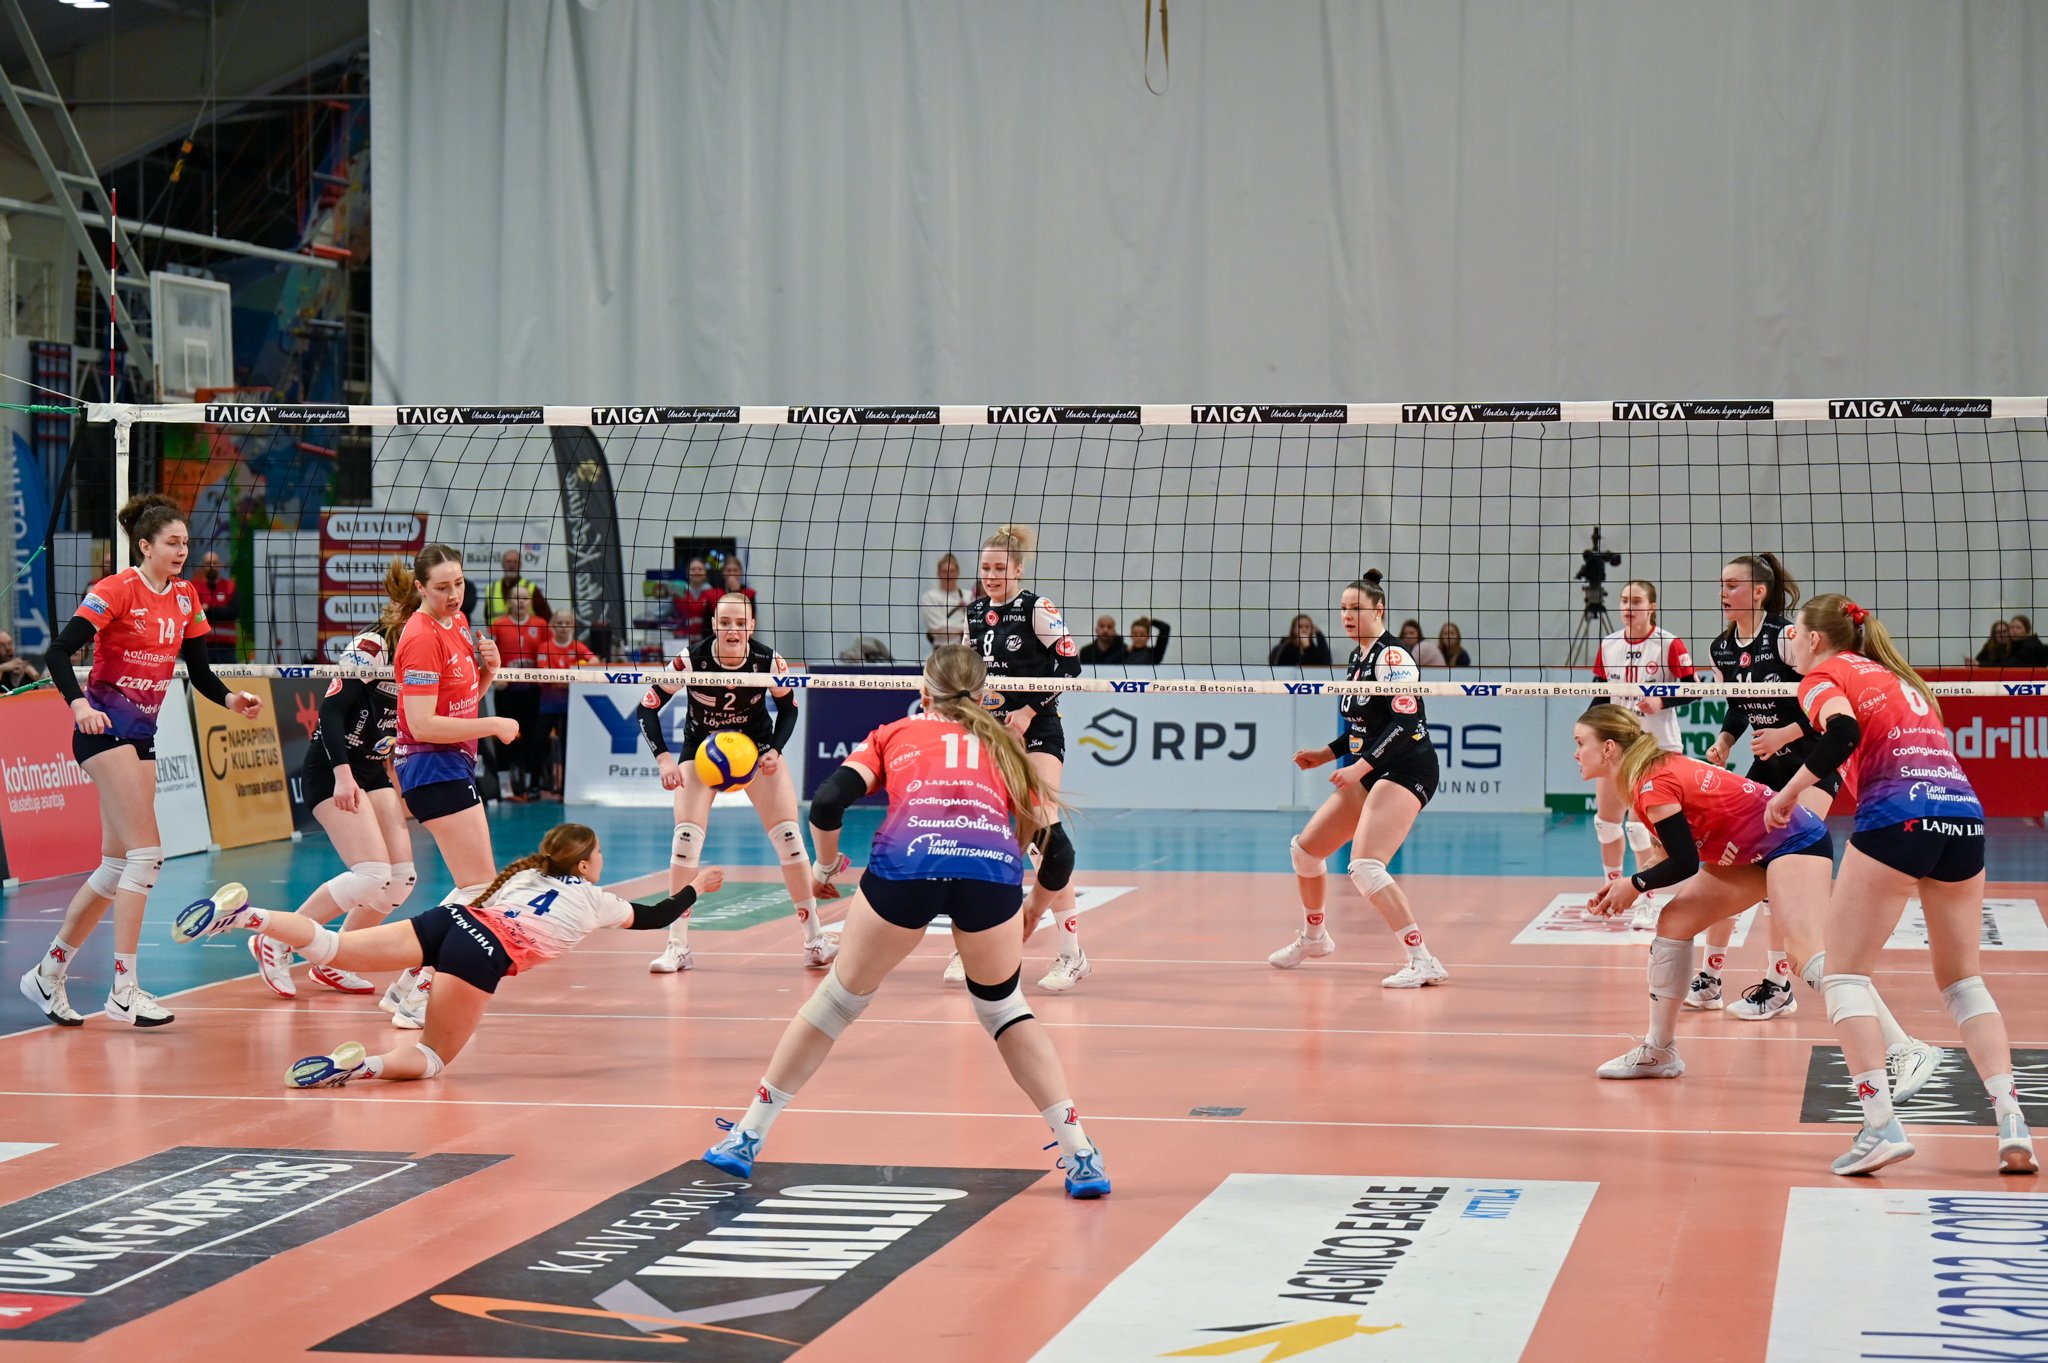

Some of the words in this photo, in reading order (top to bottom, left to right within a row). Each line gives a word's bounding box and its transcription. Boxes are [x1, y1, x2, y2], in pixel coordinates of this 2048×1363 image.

[208, 407, 271, 422] TAIGA
[278, 409, 301, 418] Uuden
[399, 408, 464, 423] TAIGA
[471, 409, 495, 419] Uuden
[593, 408, 659, 423] TAIGA
[667, 409, 691, 419] Uuden
[791, 407, 857, 423] TAIGA
[865, 409, 890, 418] Uuden
[988, 407, 1055, 422] TAIGA
[1065, 408, 1091, 418] Uuden
[1192, 407, 1260, 422] TAIGA
[1270, 408, 1297, 418] Uuden
[1404, 406, 1472, 421] TAIGA
[1483, 408, 1508, 416] Uuden
[1615, 403, 1683, 419] TAIGA
[1694, 405, 1721, 414] Uuden
[1830, 402, 1900, 417] TAIGA
[1911, 403, 1938, 412] Uuden
[157, 618, 175, 644] 14
[983, 629, 994, 656] 8
[215, 669, 254, 677] tonista.
[277, 667, 314, 678] YBT
[316, 670, 352, 678] Parasta
[354, 670, 394, 678] Betoni
[524, 672, 578, 681] Betonista.
[604, 672, 643, 684] YBT
[645, 676, 687, 684] Parasta
[690, 676, 745, 685] Betonista.
[772, 676, 811, 687] YBT
[813, 679, 856, 688] Parasta
[860, 680, 915, 688] Betonista.
[1029, 683, 1085, 692] Betonista.
[1110, 681, 1150, 692] YBT
[1153, 684, 1196, 692] Parasta
[1199, 684, 1257, 692] Betonista.
[1284, 683, 1324, 694] YBT
[1327, 686, 1372, 694] Parasta
[1375, 686, 1433, 694] Betonista.
[1461, 684, 1502, 696] YBT
[1505, 687, 1549, 695] Parasta
[1552, 688, 1612, 696] Betonista.
[1639, 685, 1681, 696] YBT
[1683, 688, 1728, 696] Parasta
[1730, 688, 1791, 696] Betonista.
[2003, 684, 2046, 696] YBT
[723, 692, 736, 710] 2
[1153, 722, 1256, 762] RPJ
[1428, 724, 1502, 769] AS
[941, 733, 980, 769] 11
[231, 748, 279, 770] KULJETUS
[609, 764, 659, 777] Paras
[1438, 780, 1502, 794] UNNOT
[1926, 786, 1946, 794] LAPIN
[1922, 819, 1964, 836] LAPIN
[1967, 820, 1984, 836] LIH
[930, 839, 958, 847] LAPIN
[527, 888, 559, 916] 4
[445, 904, 472, 930] LAPIN
[468, 927, 496, 957] LIHA
[1335, 1186, 1450, 1232] EAGLE
[635, 1184, 968, 1280] KALLIO
[1278, 1236, 1413, 1306] AGNICO
